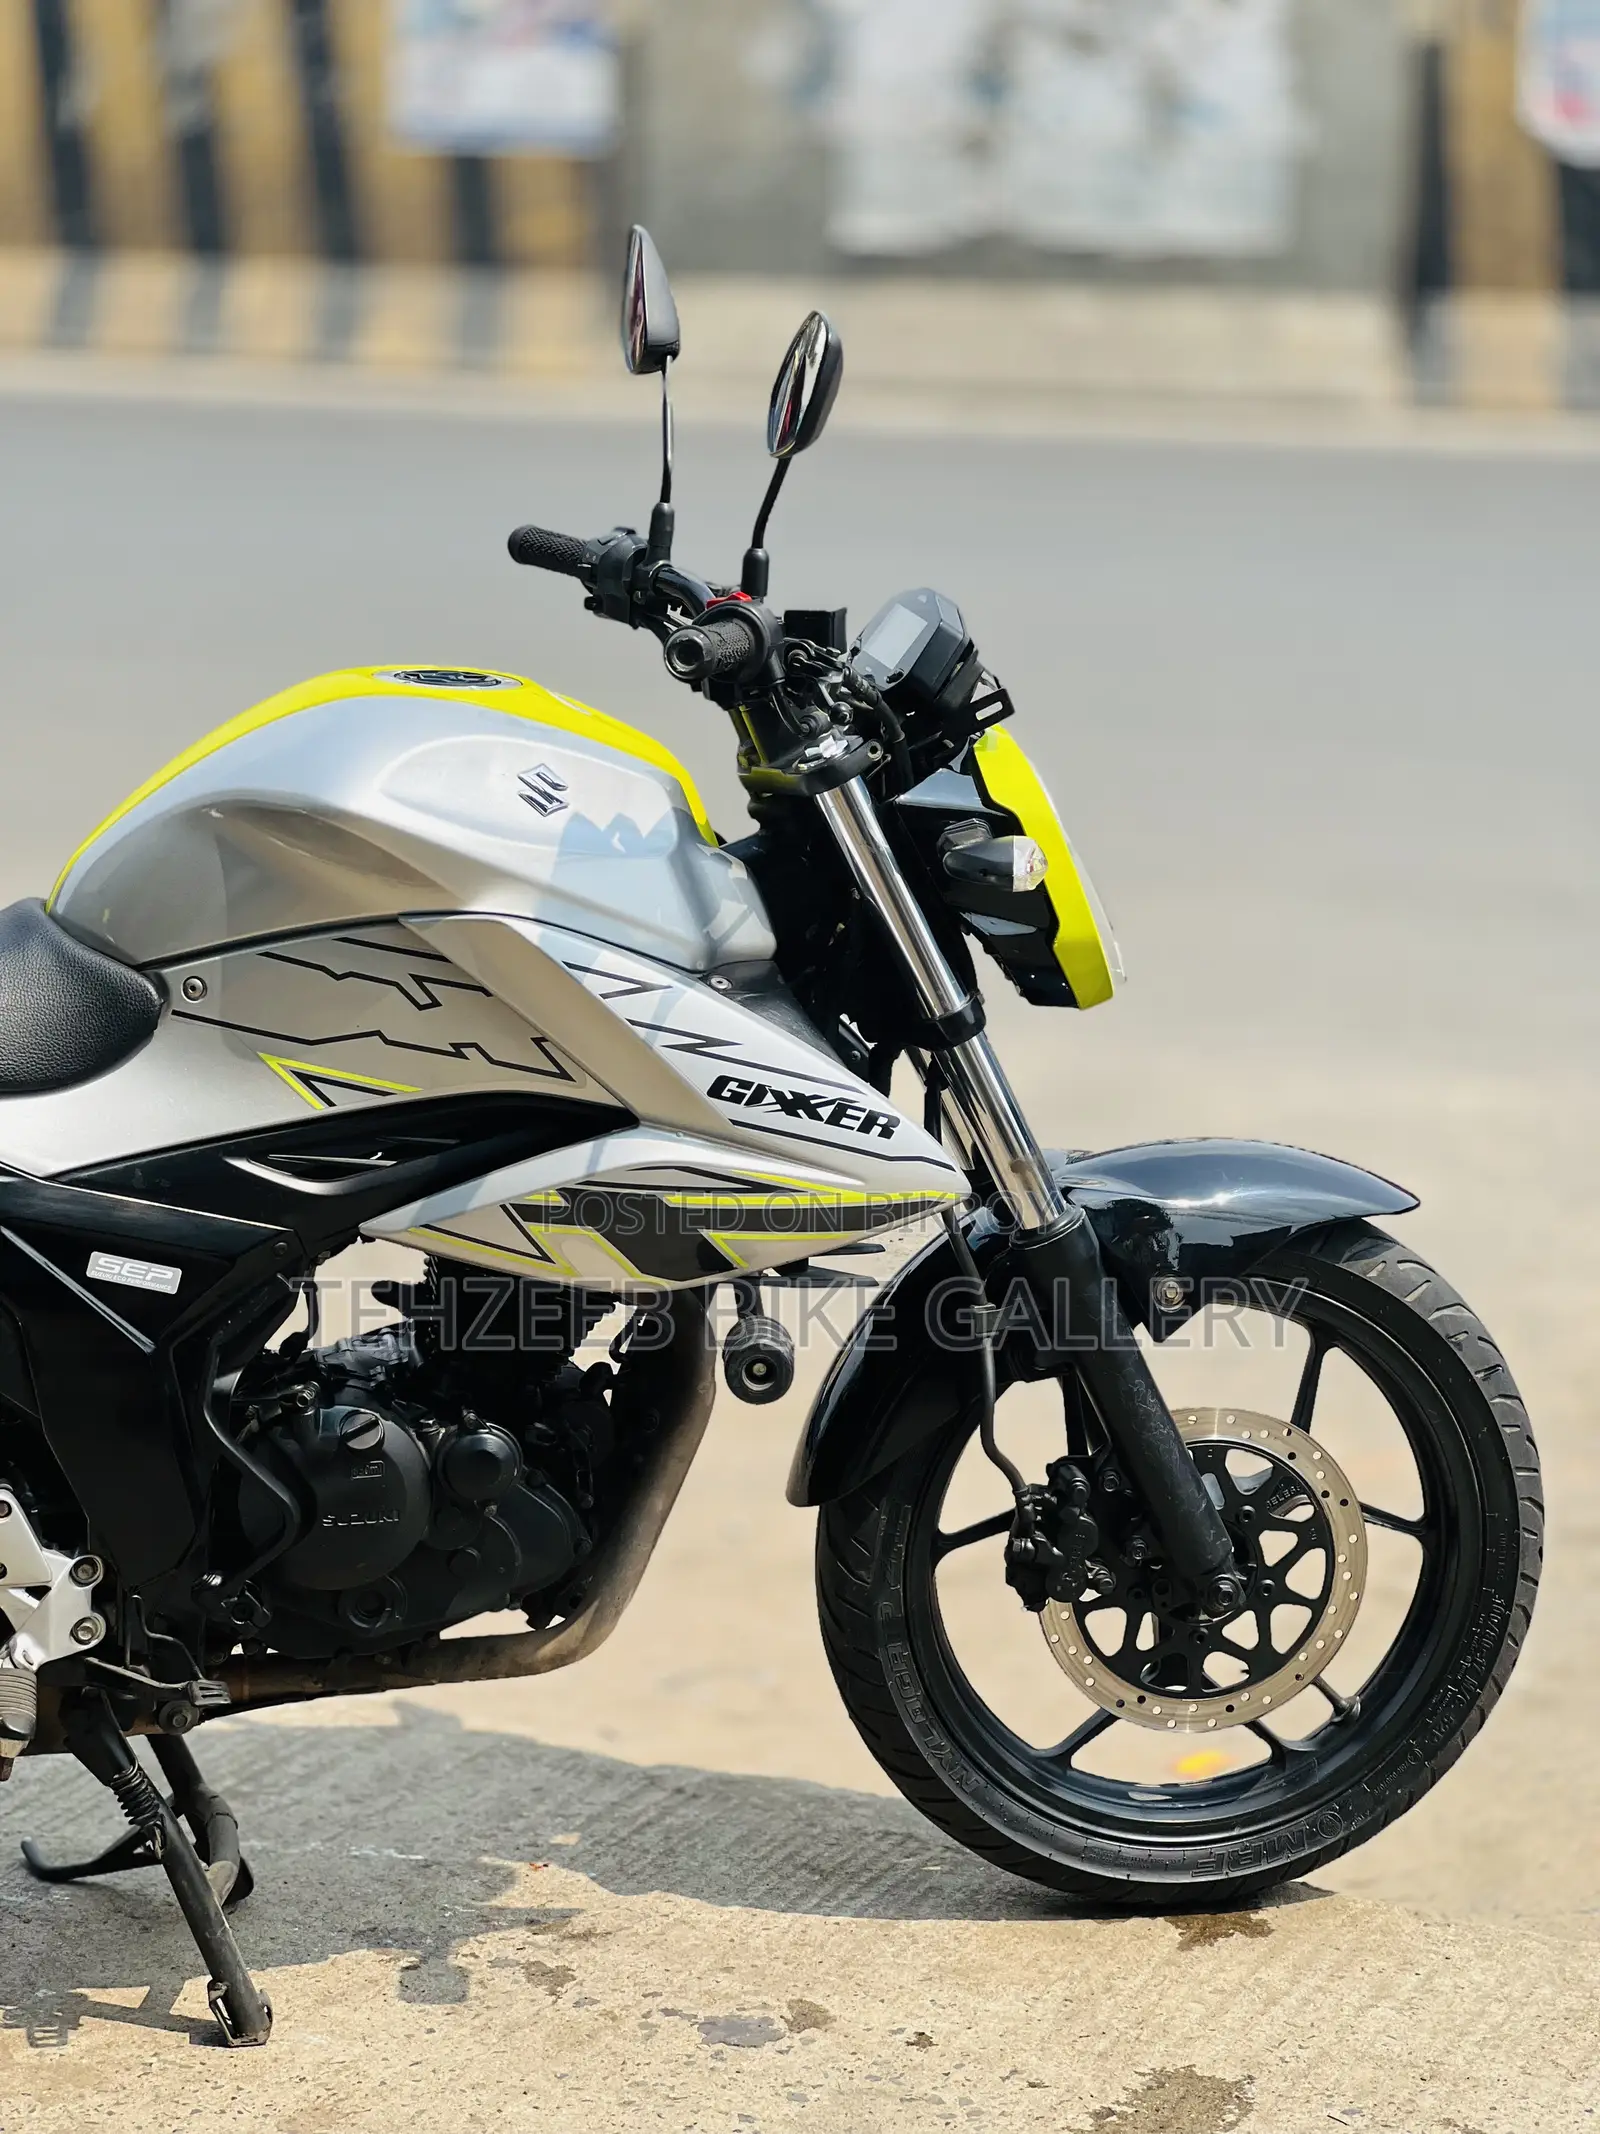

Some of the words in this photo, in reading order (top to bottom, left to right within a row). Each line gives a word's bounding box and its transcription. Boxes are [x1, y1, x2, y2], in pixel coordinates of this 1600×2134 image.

[706, 1075, 901, 1140] GIXXER
[95, 1257, 174, 1281] SEP
[1189, 1826, 1309, 1878] MRF
